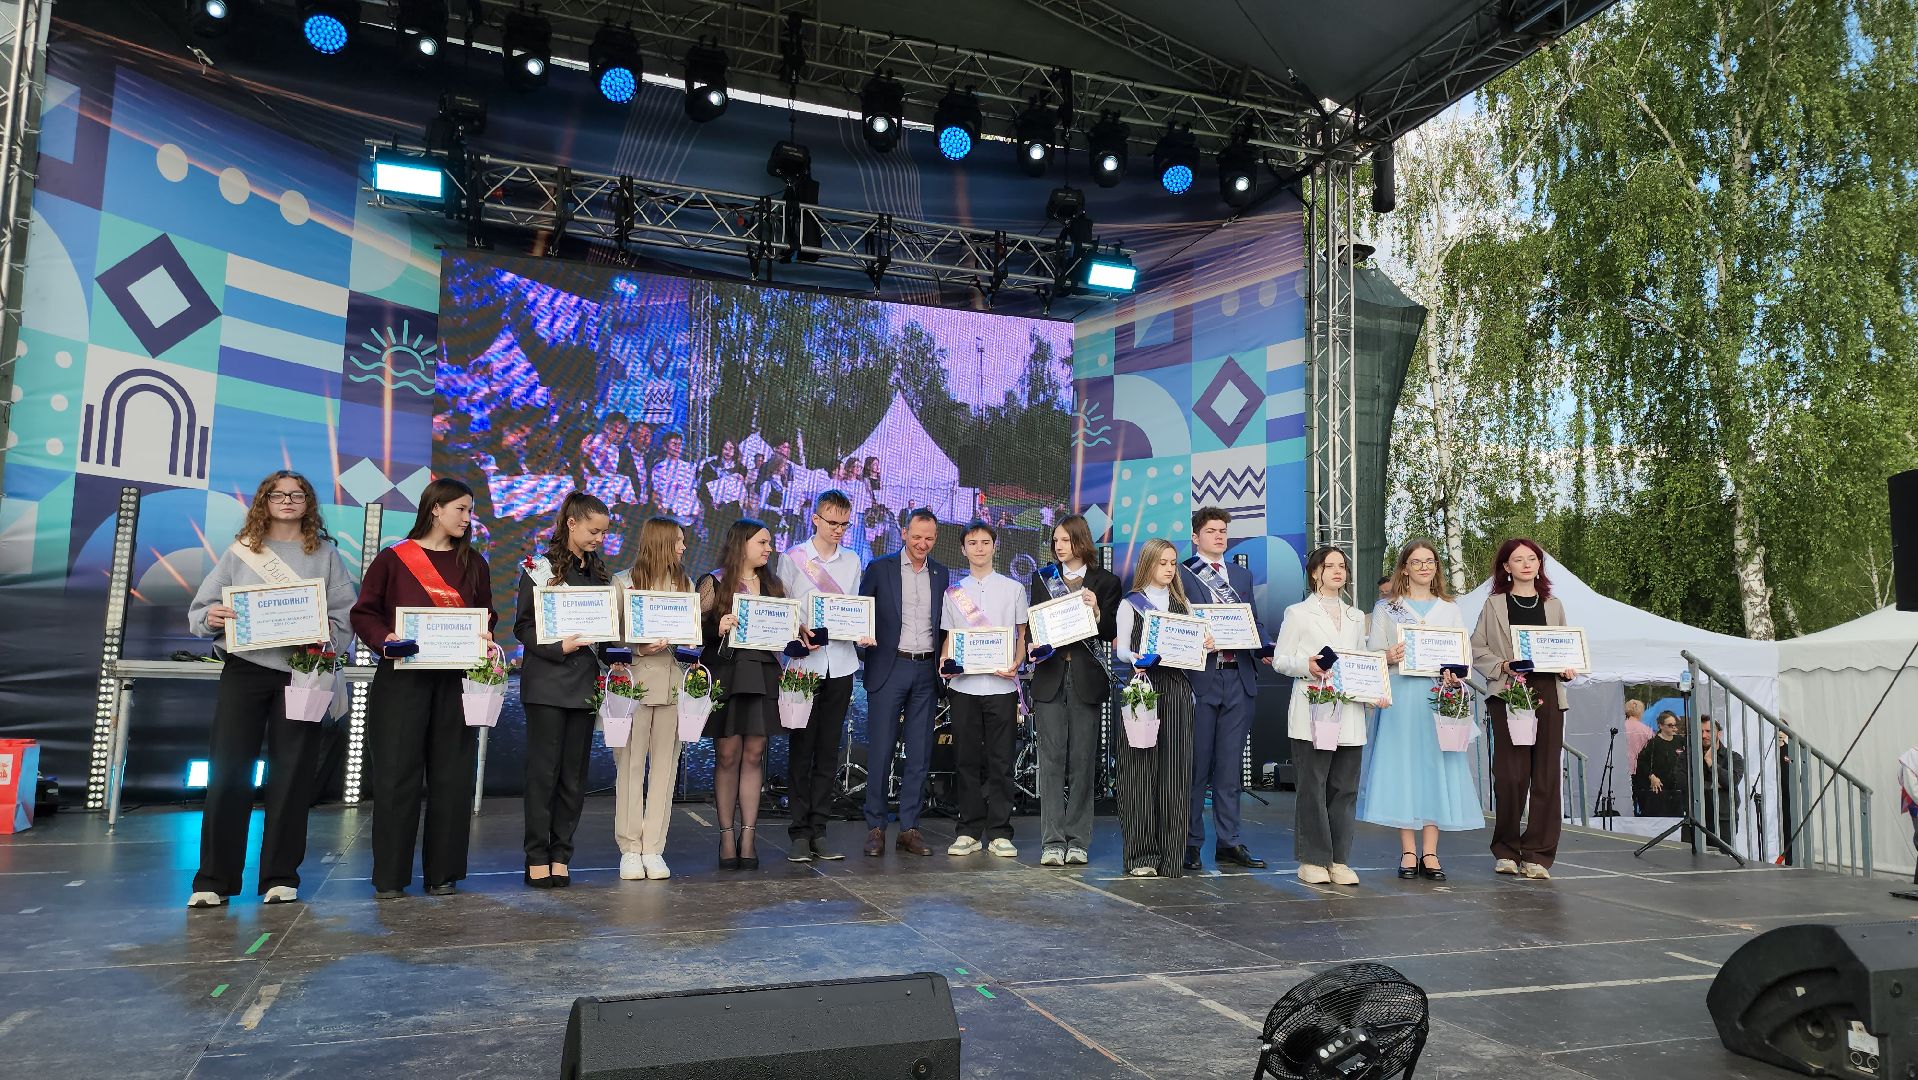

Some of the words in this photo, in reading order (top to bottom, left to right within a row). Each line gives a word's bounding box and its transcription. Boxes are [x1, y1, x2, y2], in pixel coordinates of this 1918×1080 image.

[257, 596, 309, 609] СЕРТИФИКАТ
[562, 599, 604, 608] СЕРТИФИКАТ
[426, 623, 473, 631] СЕРТИФИКАТ
[969, 638, 1003, 646] СЕРТИФИКАТ
[1536, 637, 1574, 645] СЕРТИФИКАТ
